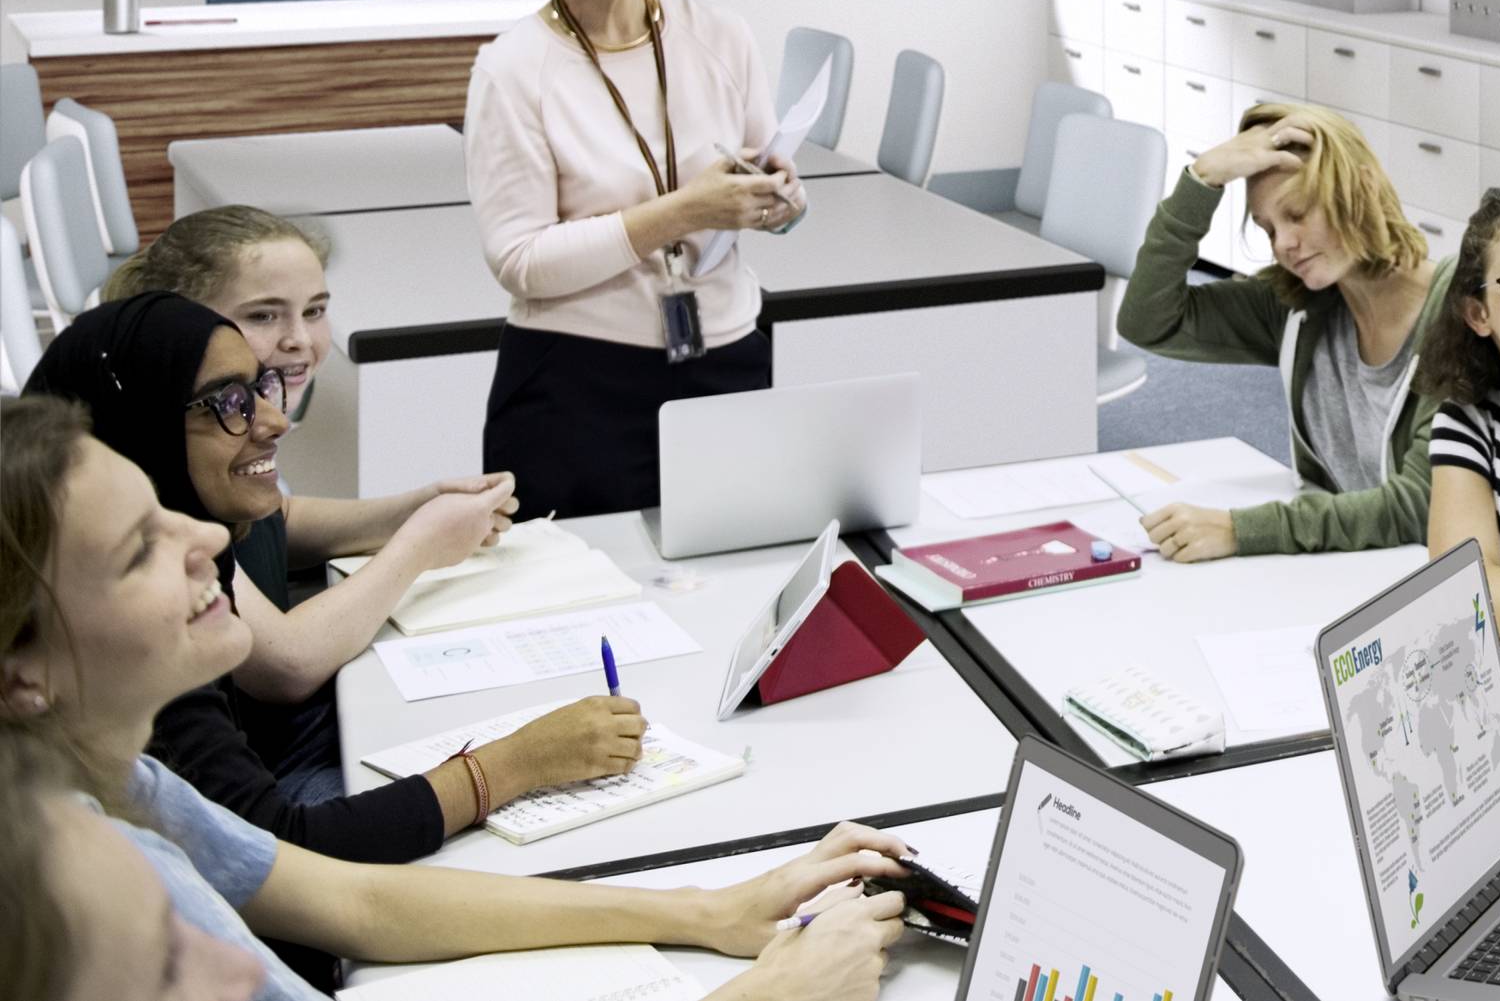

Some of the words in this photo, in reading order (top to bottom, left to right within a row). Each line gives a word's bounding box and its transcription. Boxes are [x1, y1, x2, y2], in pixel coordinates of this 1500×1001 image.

[1028, 571, 1075, 588] CHEMISTRY
[1332, 637, 1383, 686] ECOEnergy
[1053, 796, 1082, 822] Headline
